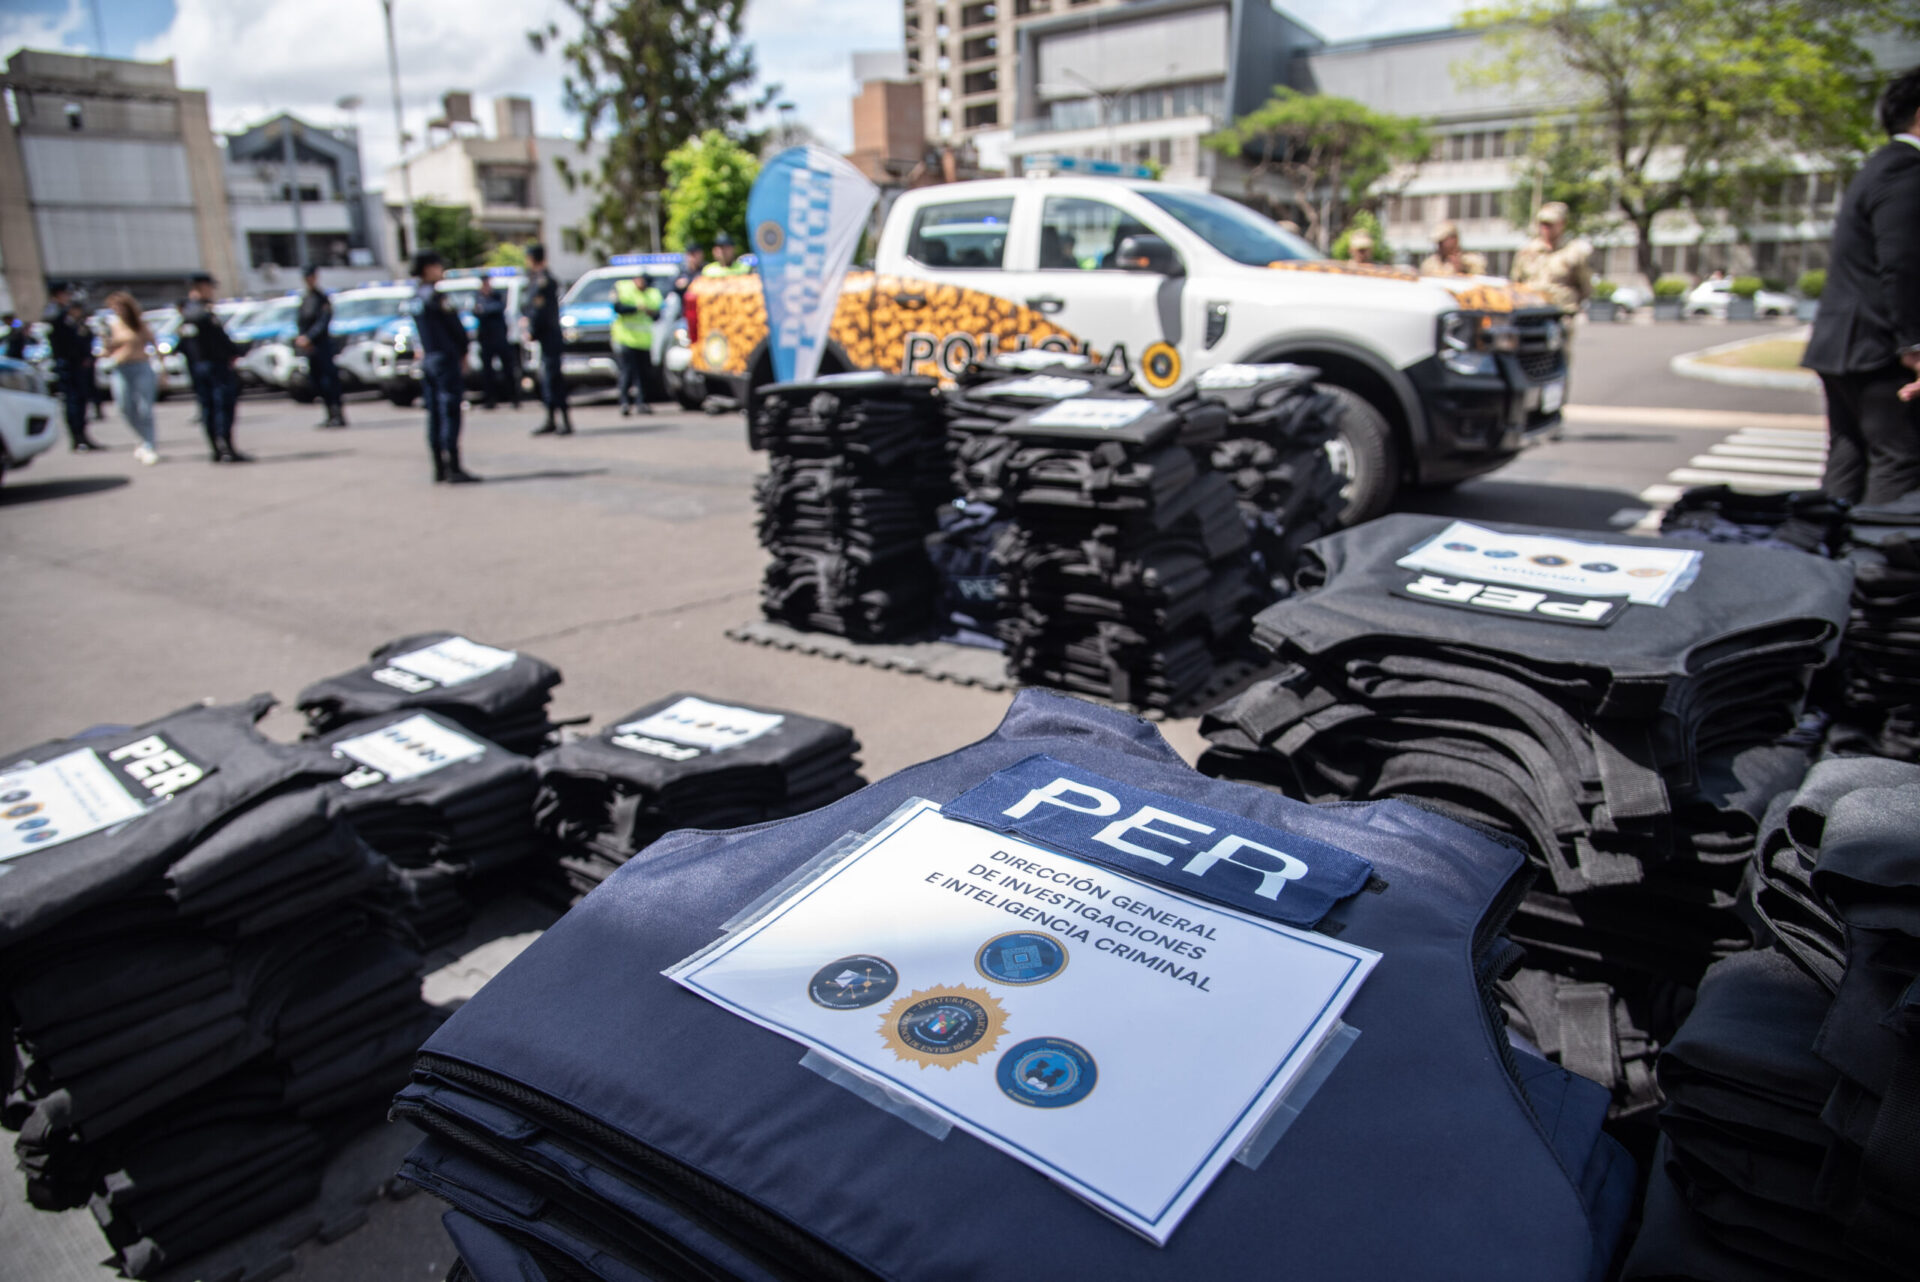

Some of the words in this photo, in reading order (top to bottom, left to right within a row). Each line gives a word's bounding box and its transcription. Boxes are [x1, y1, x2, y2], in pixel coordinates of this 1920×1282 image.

[1405, 575, 1613, 622] PER
[109, 735, 203, 797] PER
[1001, 777, 1309, 901] PER
[925, 872, 943, 883] E
[942, 877, 1090, 943] INTELIGENCIA
[1094, 937, 1210, 992] CRIMINAL
[968, 864, 1001, 882] DE
[999, 875, 1207, 960] INVESTIGACIONES
[990, 850, 1111, 900] DIRECCIÓN
[1111, 894, 1217, 941] GENERAL
